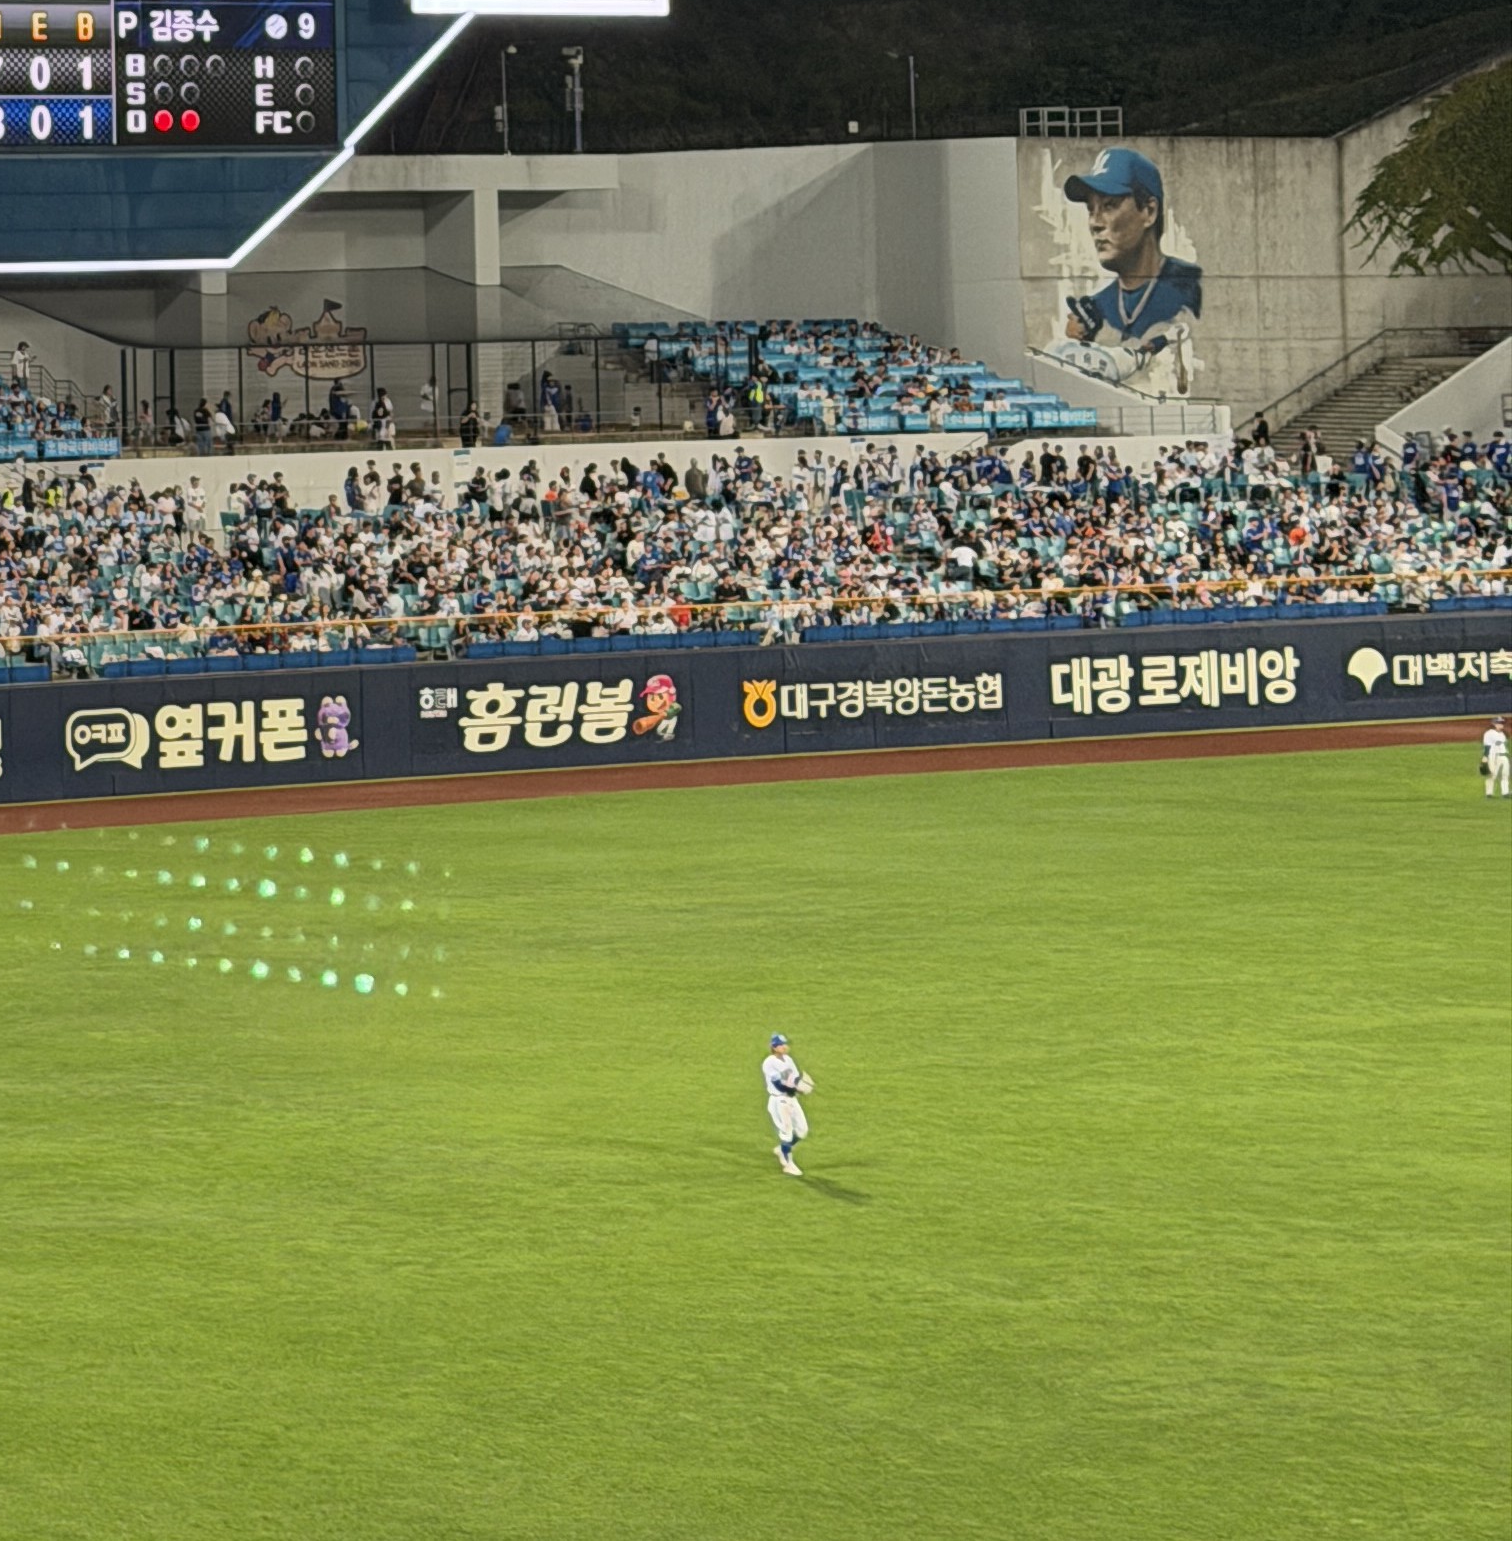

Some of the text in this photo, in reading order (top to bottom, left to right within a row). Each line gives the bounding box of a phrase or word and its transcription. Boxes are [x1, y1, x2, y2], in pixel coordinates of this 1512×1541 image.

[32, 12, 48, 41] E
[77, 12, 94, 42] B
[118, 8, 316, 43] P 김종수 9
[29, 55, 51, 91] 0
[77, 55, 93, 91] 1
[125, 53, 146, 78] B
[255, 55, 274, 79] H
[126, 81, 146, 106] S
[255, 83, 274, 107] E
[255, 110, 293, 134] FC
[780, 672, 1003, 721] 대구경북양돈농협
[1050, 646, 1301, 715] 대광 로제비앙
[458, 678, 635, 753] 홈런볼
[155, 696, 308, 769] 옆커폰
